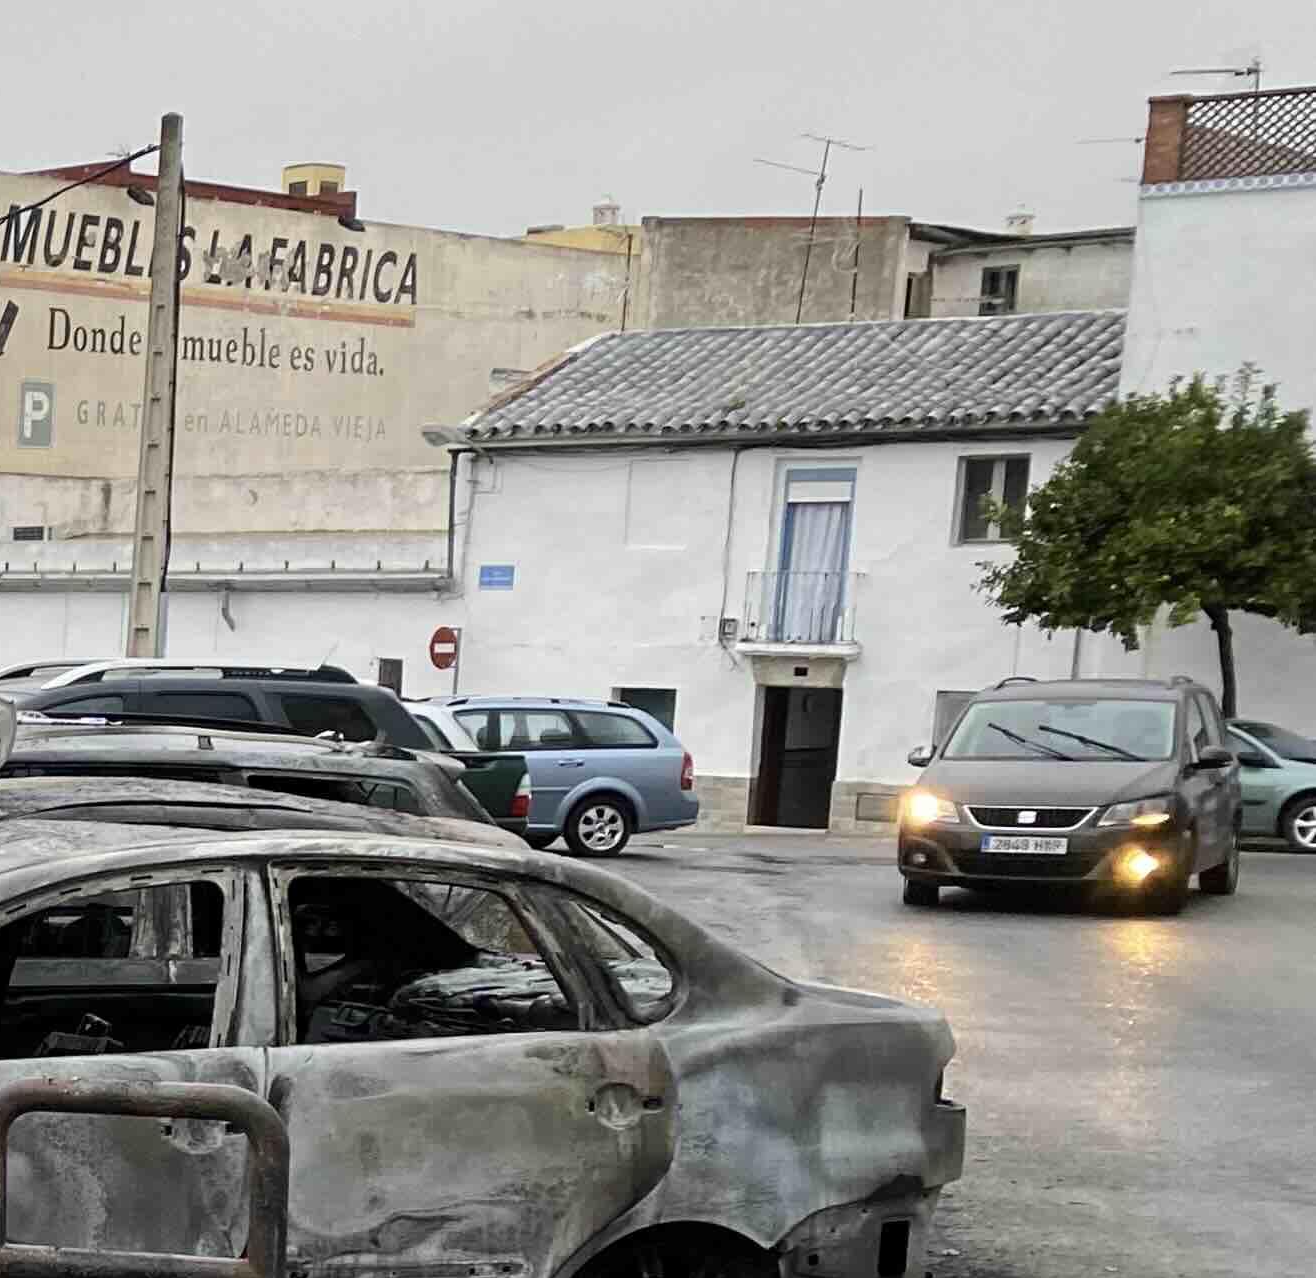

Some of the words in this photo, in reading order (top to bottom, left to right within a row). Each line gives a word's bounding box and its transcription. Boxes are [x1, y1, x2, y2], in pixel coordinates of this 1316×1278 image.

[0, 204, 196, 281] MUEBLS
[264, 236, 418, 305] FABRICA
[48, 307, 142, 355] Donde
[182, 327, 281, 369] mueble
[290, 345, 315, 372] es
[325, 337, 384, 376] vida.
[23, 391, 50, 438] P
[77, 400, 142, 428] GRAT
[184, 413, 209, 433] en
[219, 409, 322, 439] ALAMEDA
[332, 414, 387, 443] VIEJA
